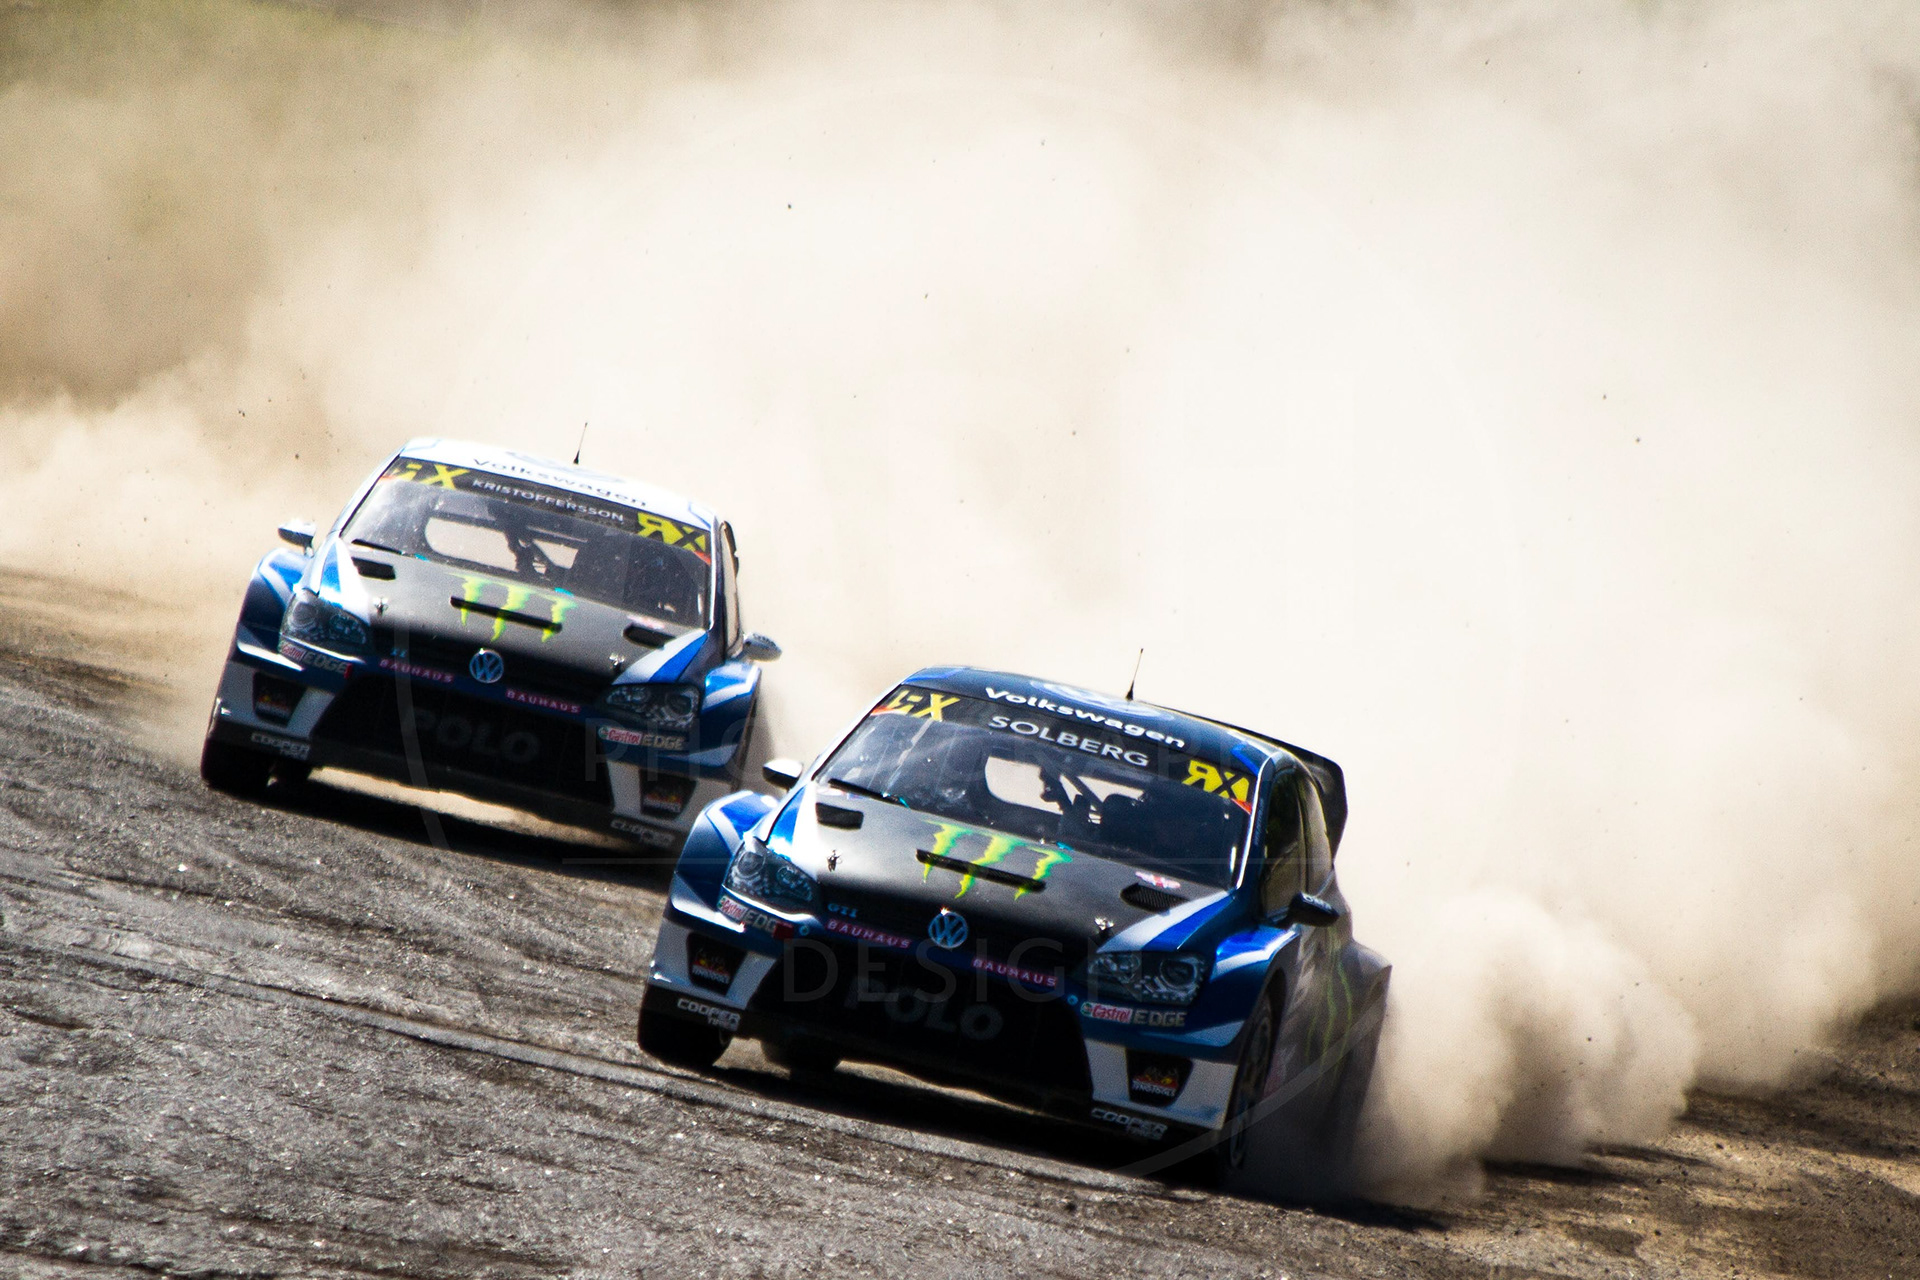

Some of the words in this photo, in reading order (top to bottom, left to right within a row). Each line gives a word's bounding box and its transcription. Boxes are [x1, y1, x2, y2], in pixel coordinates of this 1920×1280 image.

[473, 458, 647, 507] Volkswagen
[472, 479, 624, 522] KRISTOFFERSSON
[379, 659, 454, 683] BAUHAUS
[505, 689, 581, 713] BAUHAUS
[985, 687, 1186, 748] Volkswagen
[608, 729, 641, 745] Castrol
[642, 734, 685, 750] EDGE
[988, 716, 1150, 767] SOLBERG
[723, 901, 746, 921] Castrol
[826, 919, 913, 949] BAUHAUS
[972, 957, 1058, 987] BAUHAUS
[677, 997, 741, 1031] COOPER
[843, 976, 1004, 1042] POLO
[1092, 1004, 1131, 1022] Castrol
[1133, 1009, 1188, 1028] EDGE
